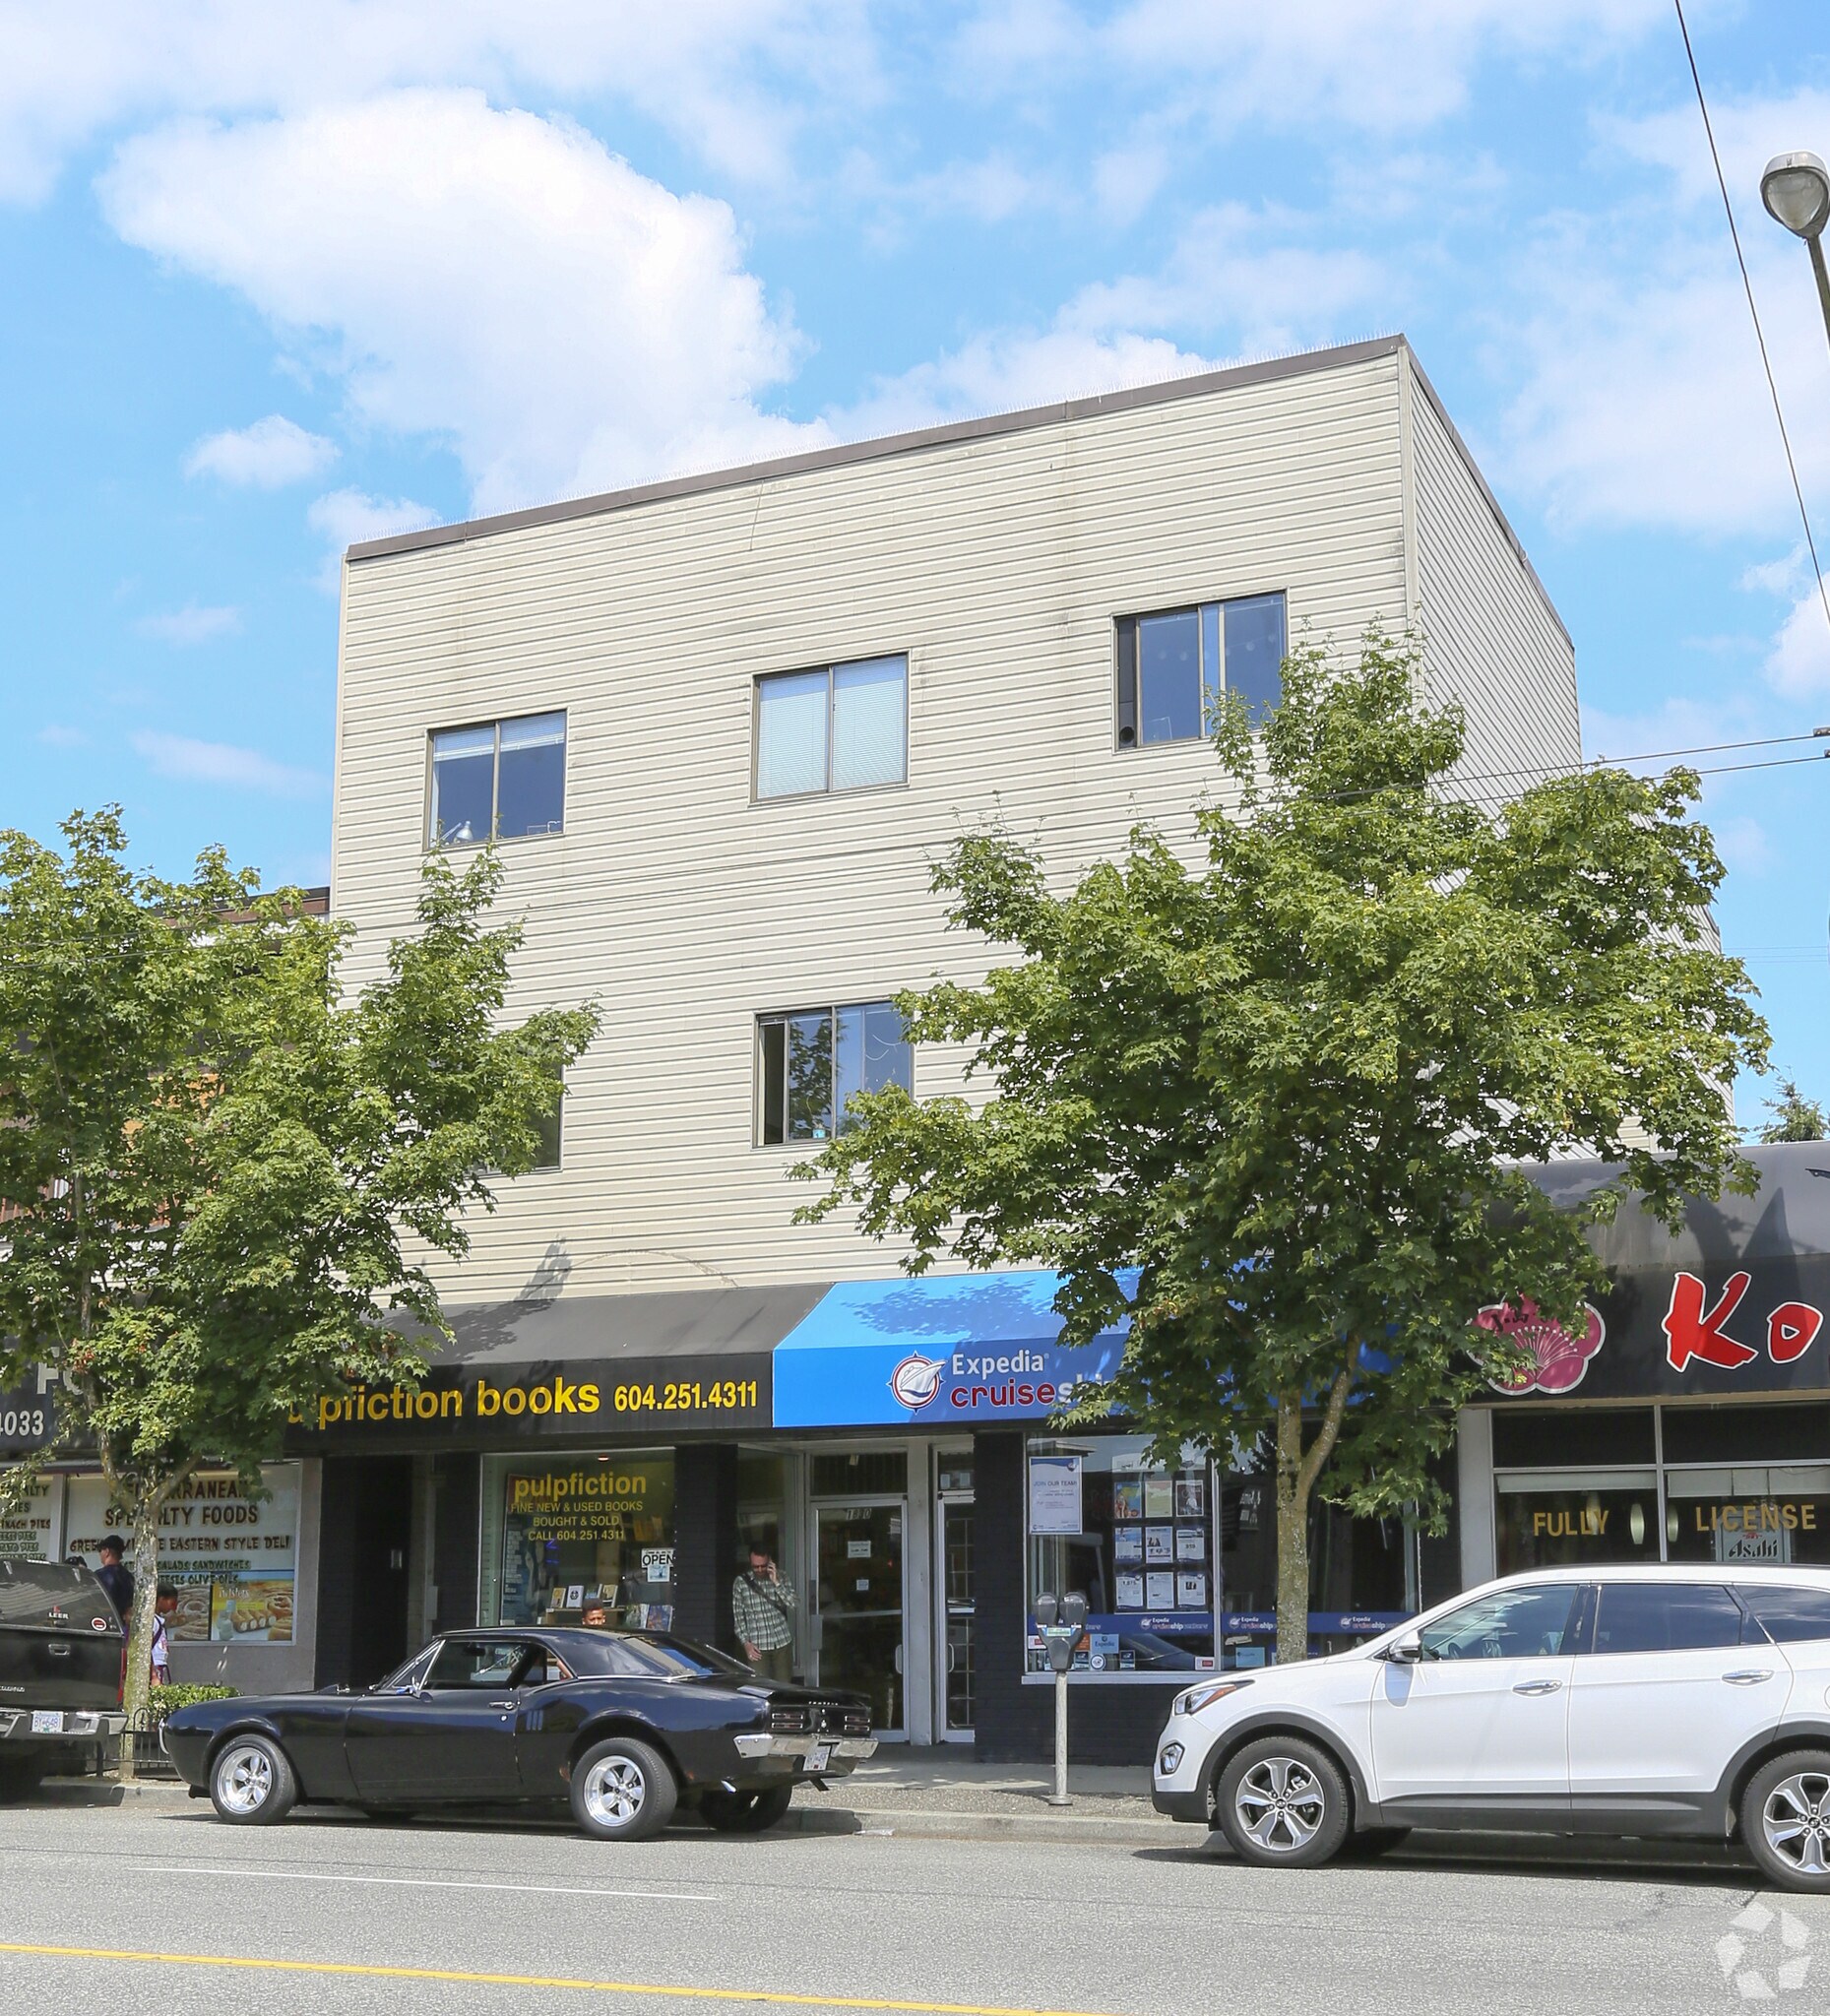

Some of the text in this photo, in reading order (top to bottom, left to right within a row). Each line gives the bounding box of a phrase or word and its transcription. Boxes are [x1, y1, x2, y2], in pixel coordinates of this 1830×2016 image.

[952, 1350, 1044, 1380] Expedia
[287, 1377, 757, 1430] pfiction books 604.251.4311
[515, 1472, 647, 1502] pulpfiction
[511, 1501, 643, 1513] FINE NEW & USED BOOKS
[105, 1504, 258, 1527] SPELTY FOODS
[534, 1516, 619, 1527] BOUGHT & SOLD
[1534, 1504, 1817, 1537] FULLY LICENSE
[30, 1520, 51, 1530] PIES
[528, 1530, 625, 1542] CALL 604.251.4311
[70, 1537, 100, 1553] GREE
[169, 1537, 220, 1551] EASTERN
[224, 1536, 260, 1550] STYLE
[264, 1535, 290, 1549] DELI
[1728, 1539, 1778, 1558] Asahi
[158, 1559, 251, 1571] SALADS SANDWICHES
[642, 1553, 673, 1566] OPEN
[158, 1575, 185, 1586] EESES
